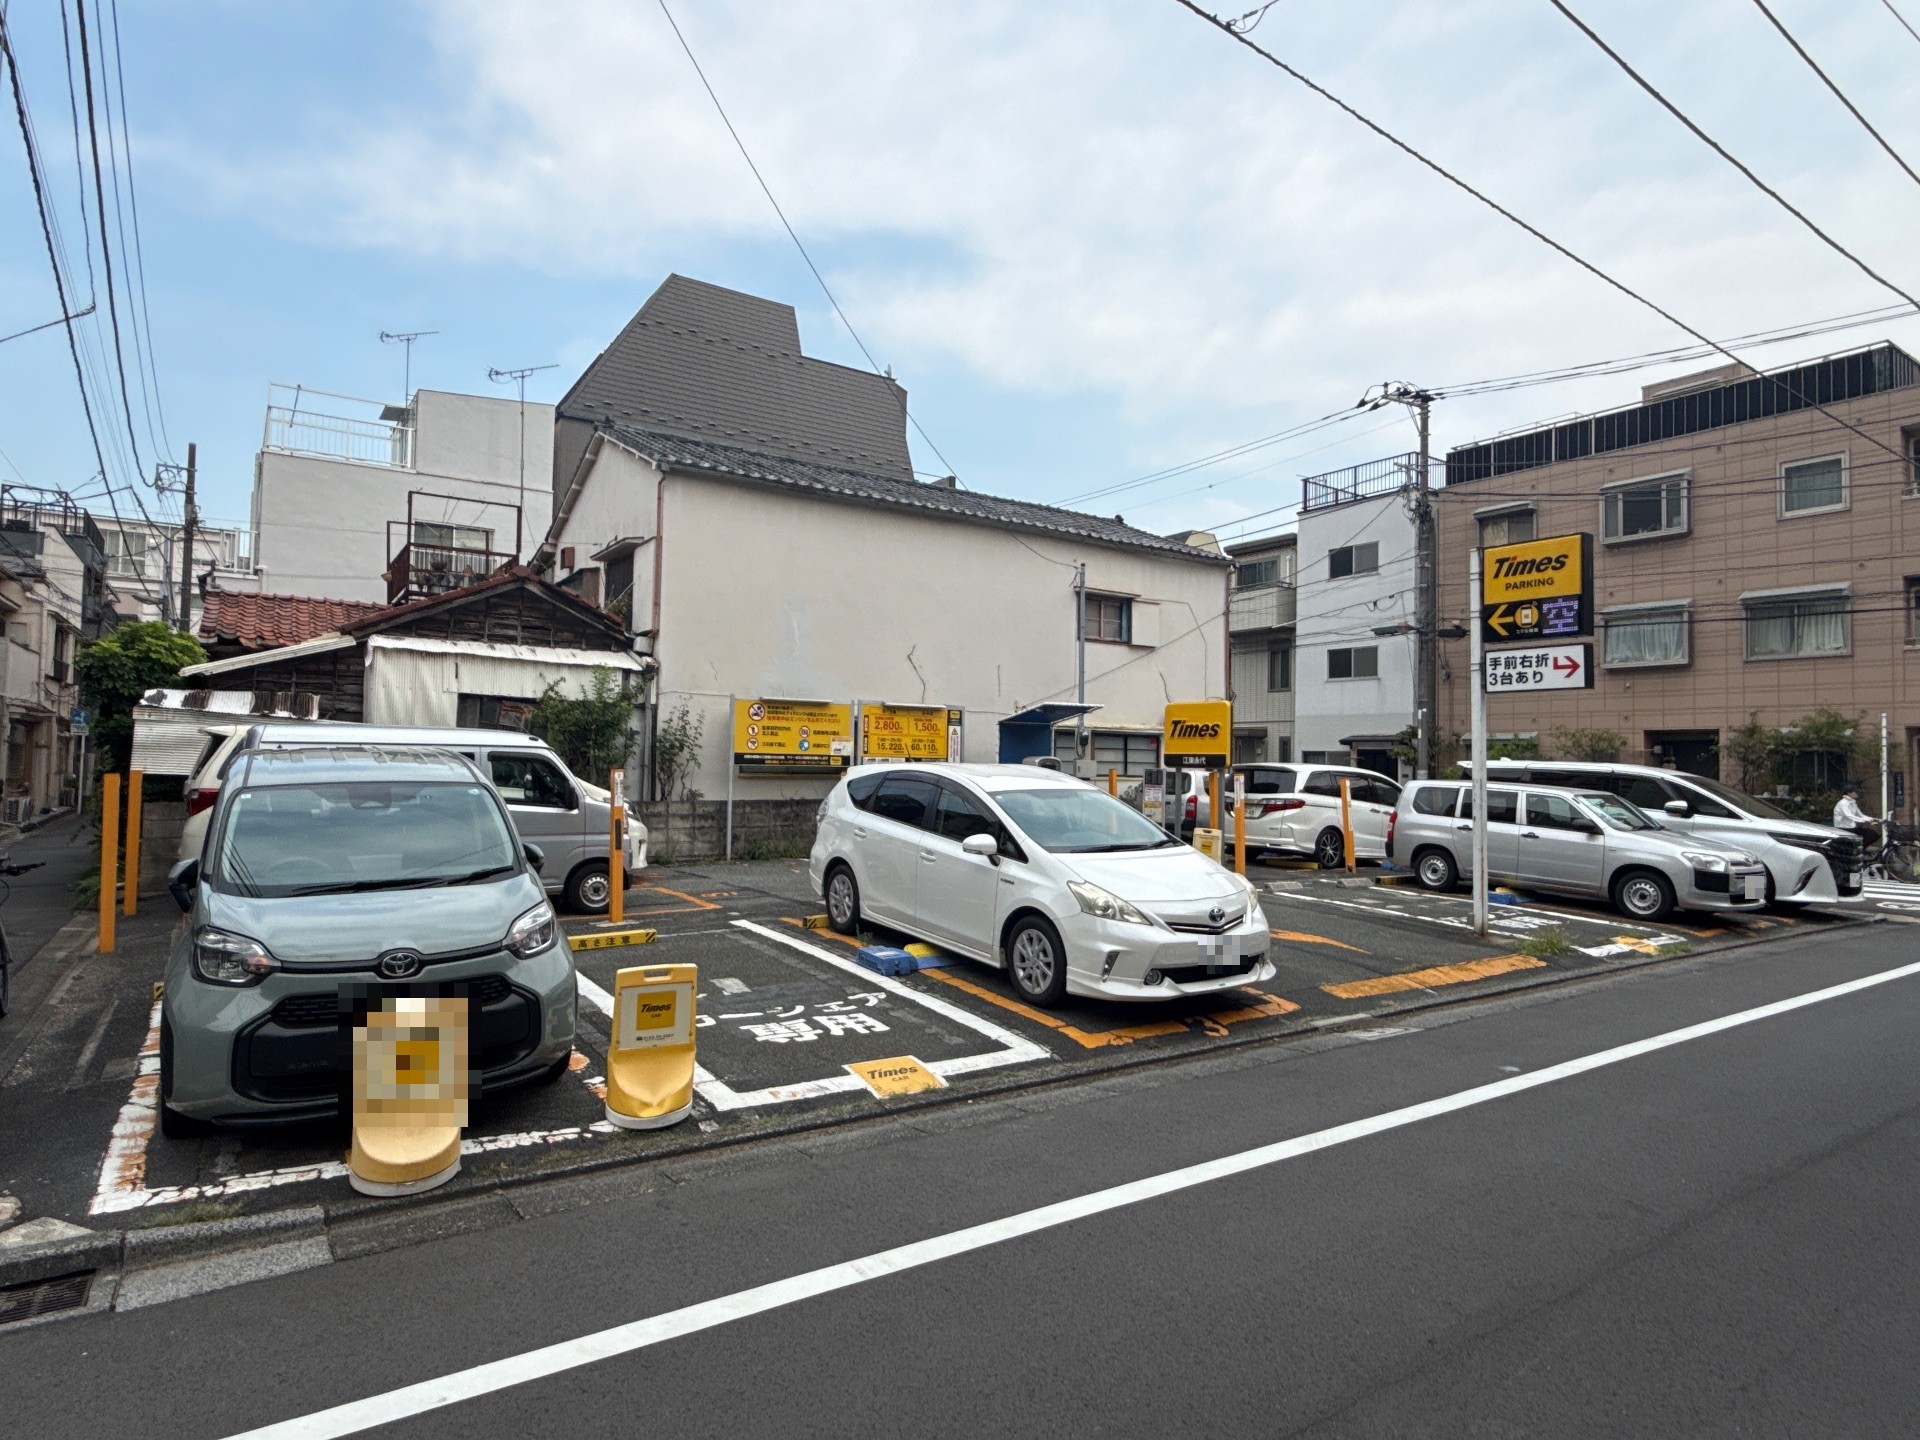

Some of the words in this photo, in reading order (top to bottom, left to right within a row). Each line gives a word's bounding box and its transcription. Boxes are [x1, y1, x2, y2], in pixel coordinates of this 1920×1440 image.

[1493, 553, 1569, 579] Times
[1505, 577, 1554, 591] PARKING
[1489, 653, 1550, 670] 手前右折
[1489, 669, 1544, 686] 3台あり
[1169, 719, 1221, 738] Times
[578, 935, 631, 949] 高さ注意
[640, 1003, 672, 1013] Times
[739, 1013, 891, 1043] 専用
[867, 1066, 918, 1080] Times
